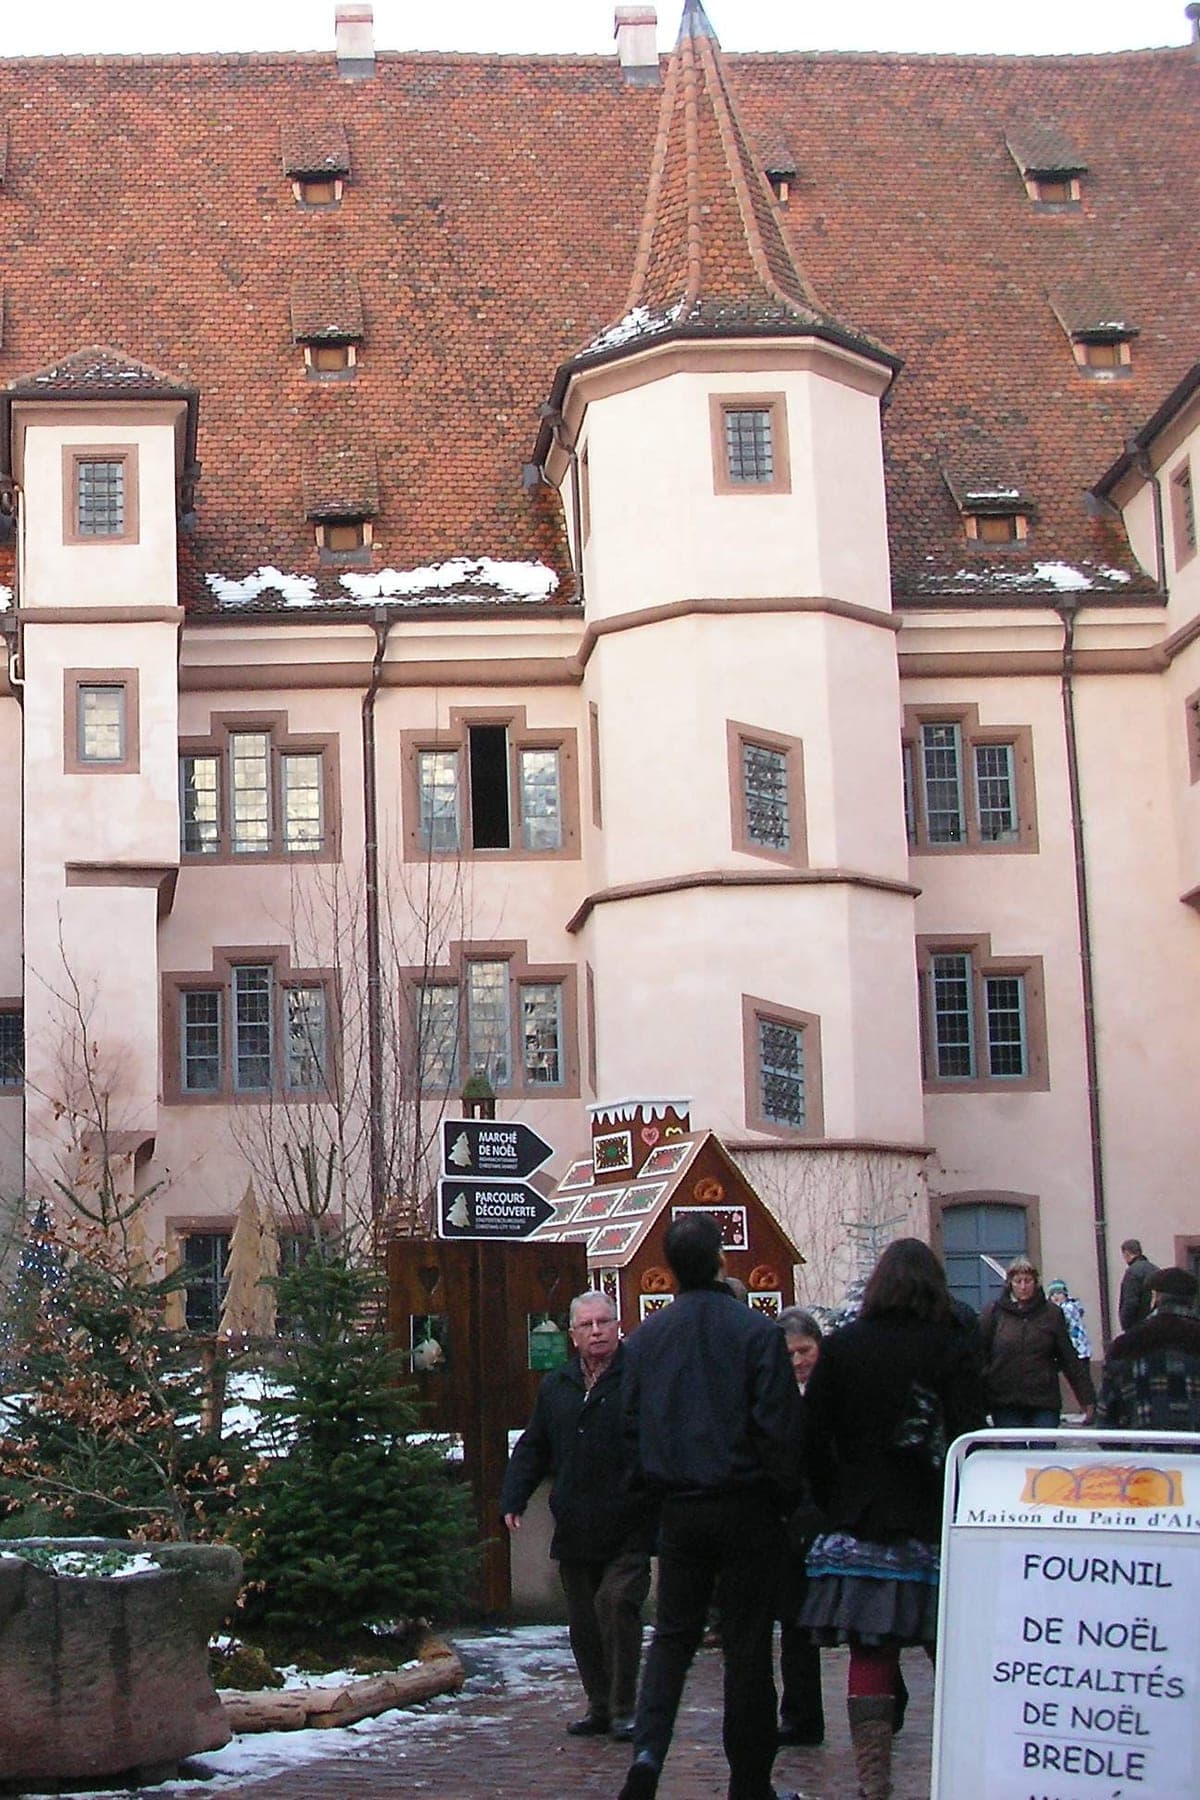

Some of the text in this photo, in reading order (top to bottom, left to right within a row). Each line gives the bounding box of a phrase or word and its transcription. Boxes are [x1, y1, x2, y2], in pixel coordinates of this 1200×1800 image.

[479, 1130, 517, 1144] MARCHÉ
[479, 1144, 517, 1157] DE NOËL
[475, 1192, 525, 1204] PARCOURS
[475, 1204, 536, 1217] DÉCOUVERTE
[967, 1510, 1042, 1524] Maison
[1052, 1510, 1077, 1524] du
[1090, 1511, 1136, 1526] Pain
[1023, 1554, 1173, 1588] FOURNIL
[1022, 1616, 1168, 1652] DE NOËL
[992, 1661, 1185, 1699] SPECIALITÉS
[1022, 1701, 1150, 1736] DE NOËL
[1022, 1741, 1145, 1781] BREDLE
